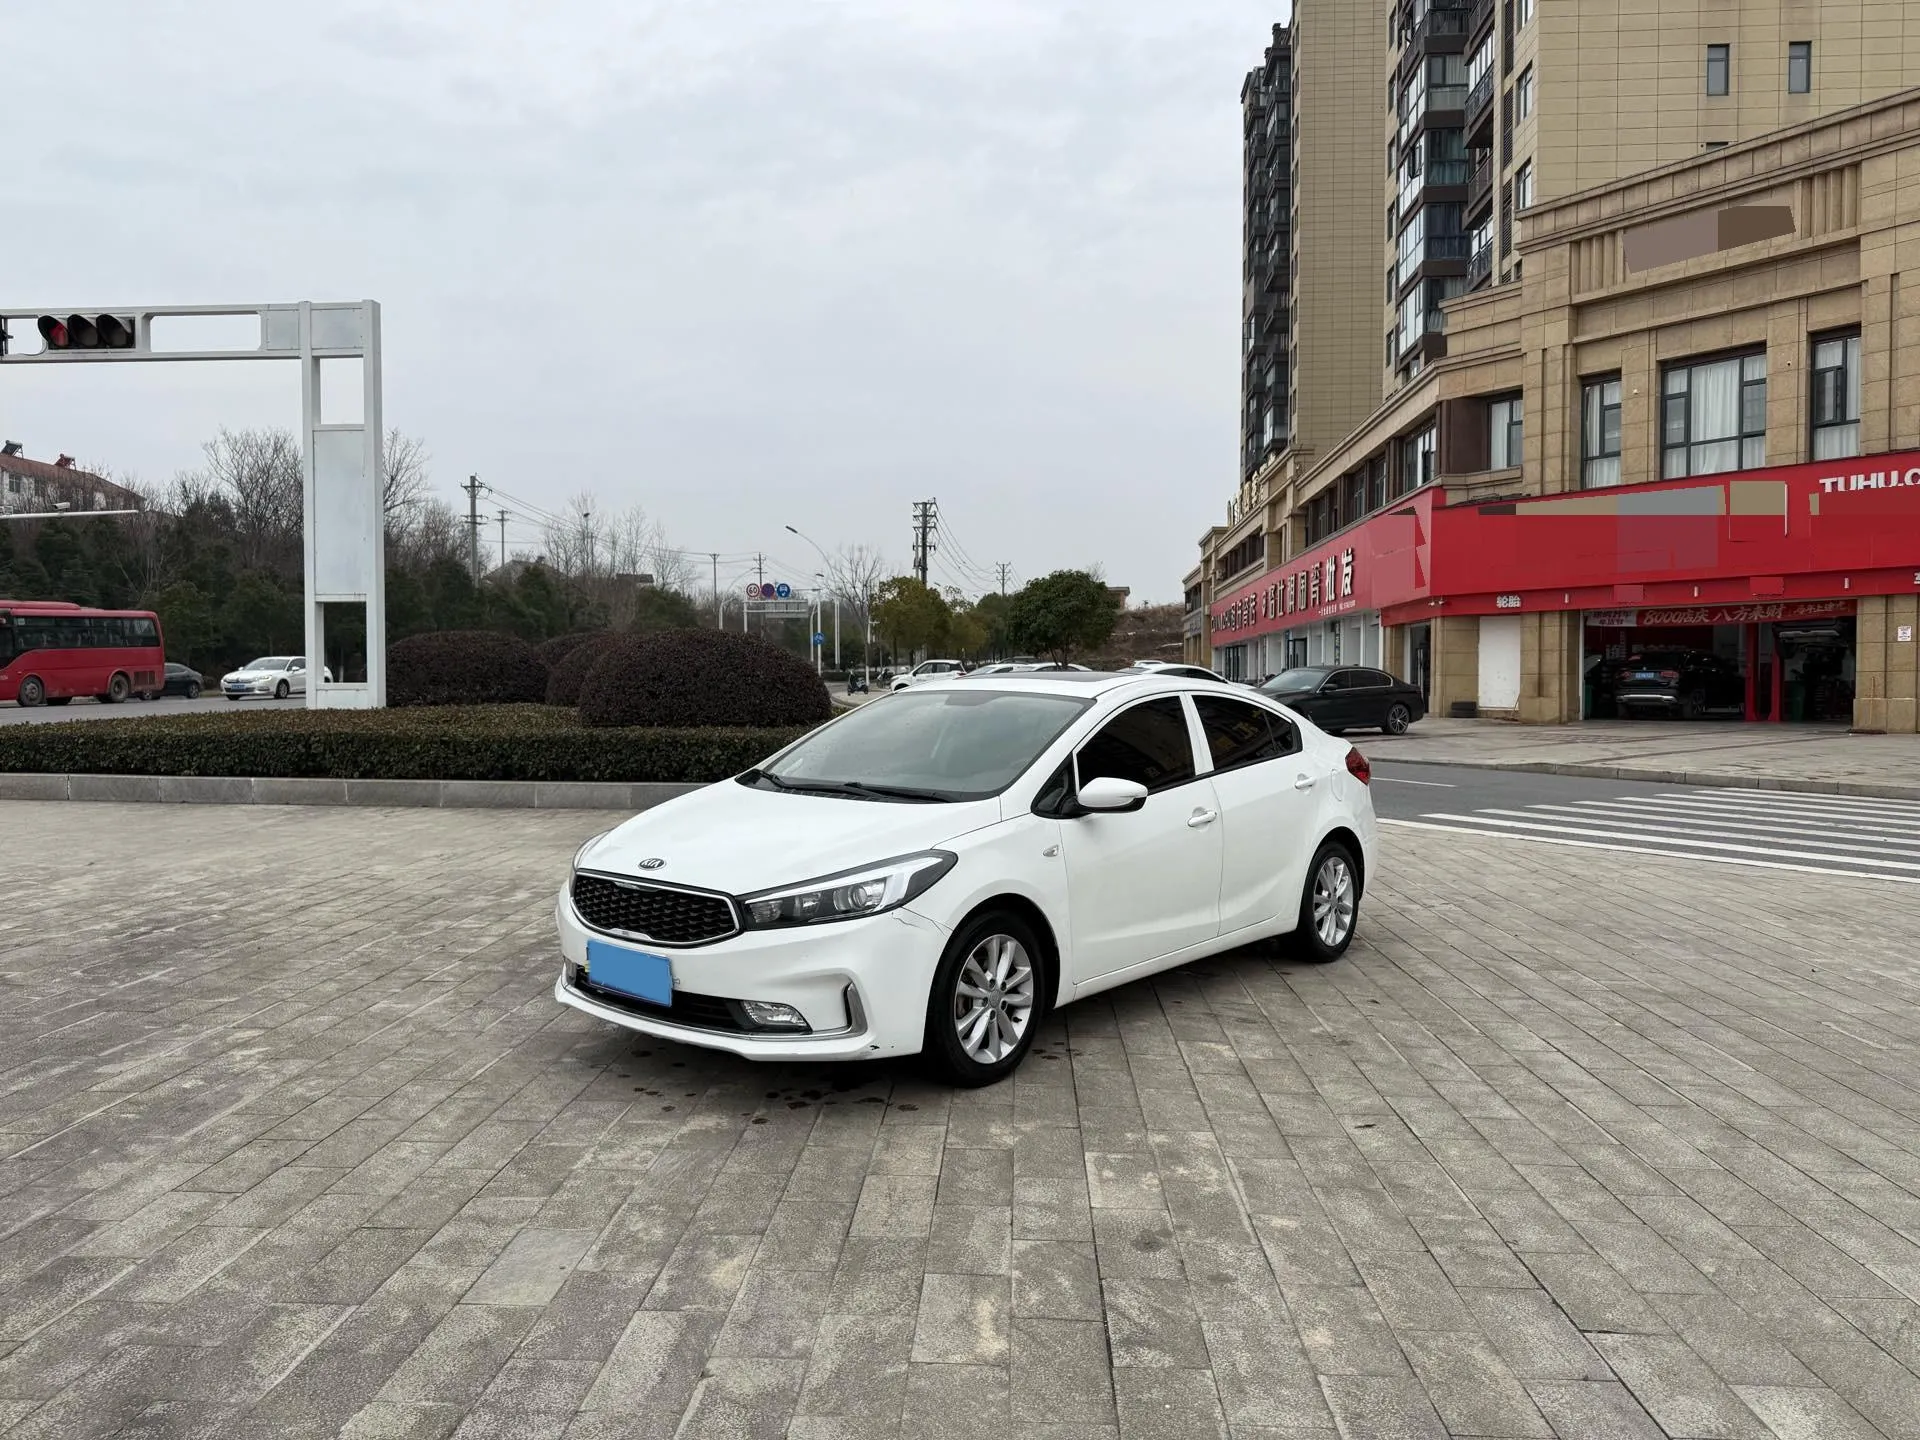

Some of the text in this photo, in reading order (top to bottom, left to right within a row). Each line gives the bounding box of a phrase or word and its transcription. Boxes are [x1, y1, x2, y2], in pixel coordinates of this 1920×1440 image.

[749, 586, 758, 594] 60
[1496, 595, 1521, 608] 轮胎
[1643, 608, 1709, 625] 8000店庆
[1712, 602, 1786, 621] 八方来财
[640, 859, 661, 868] KIA
